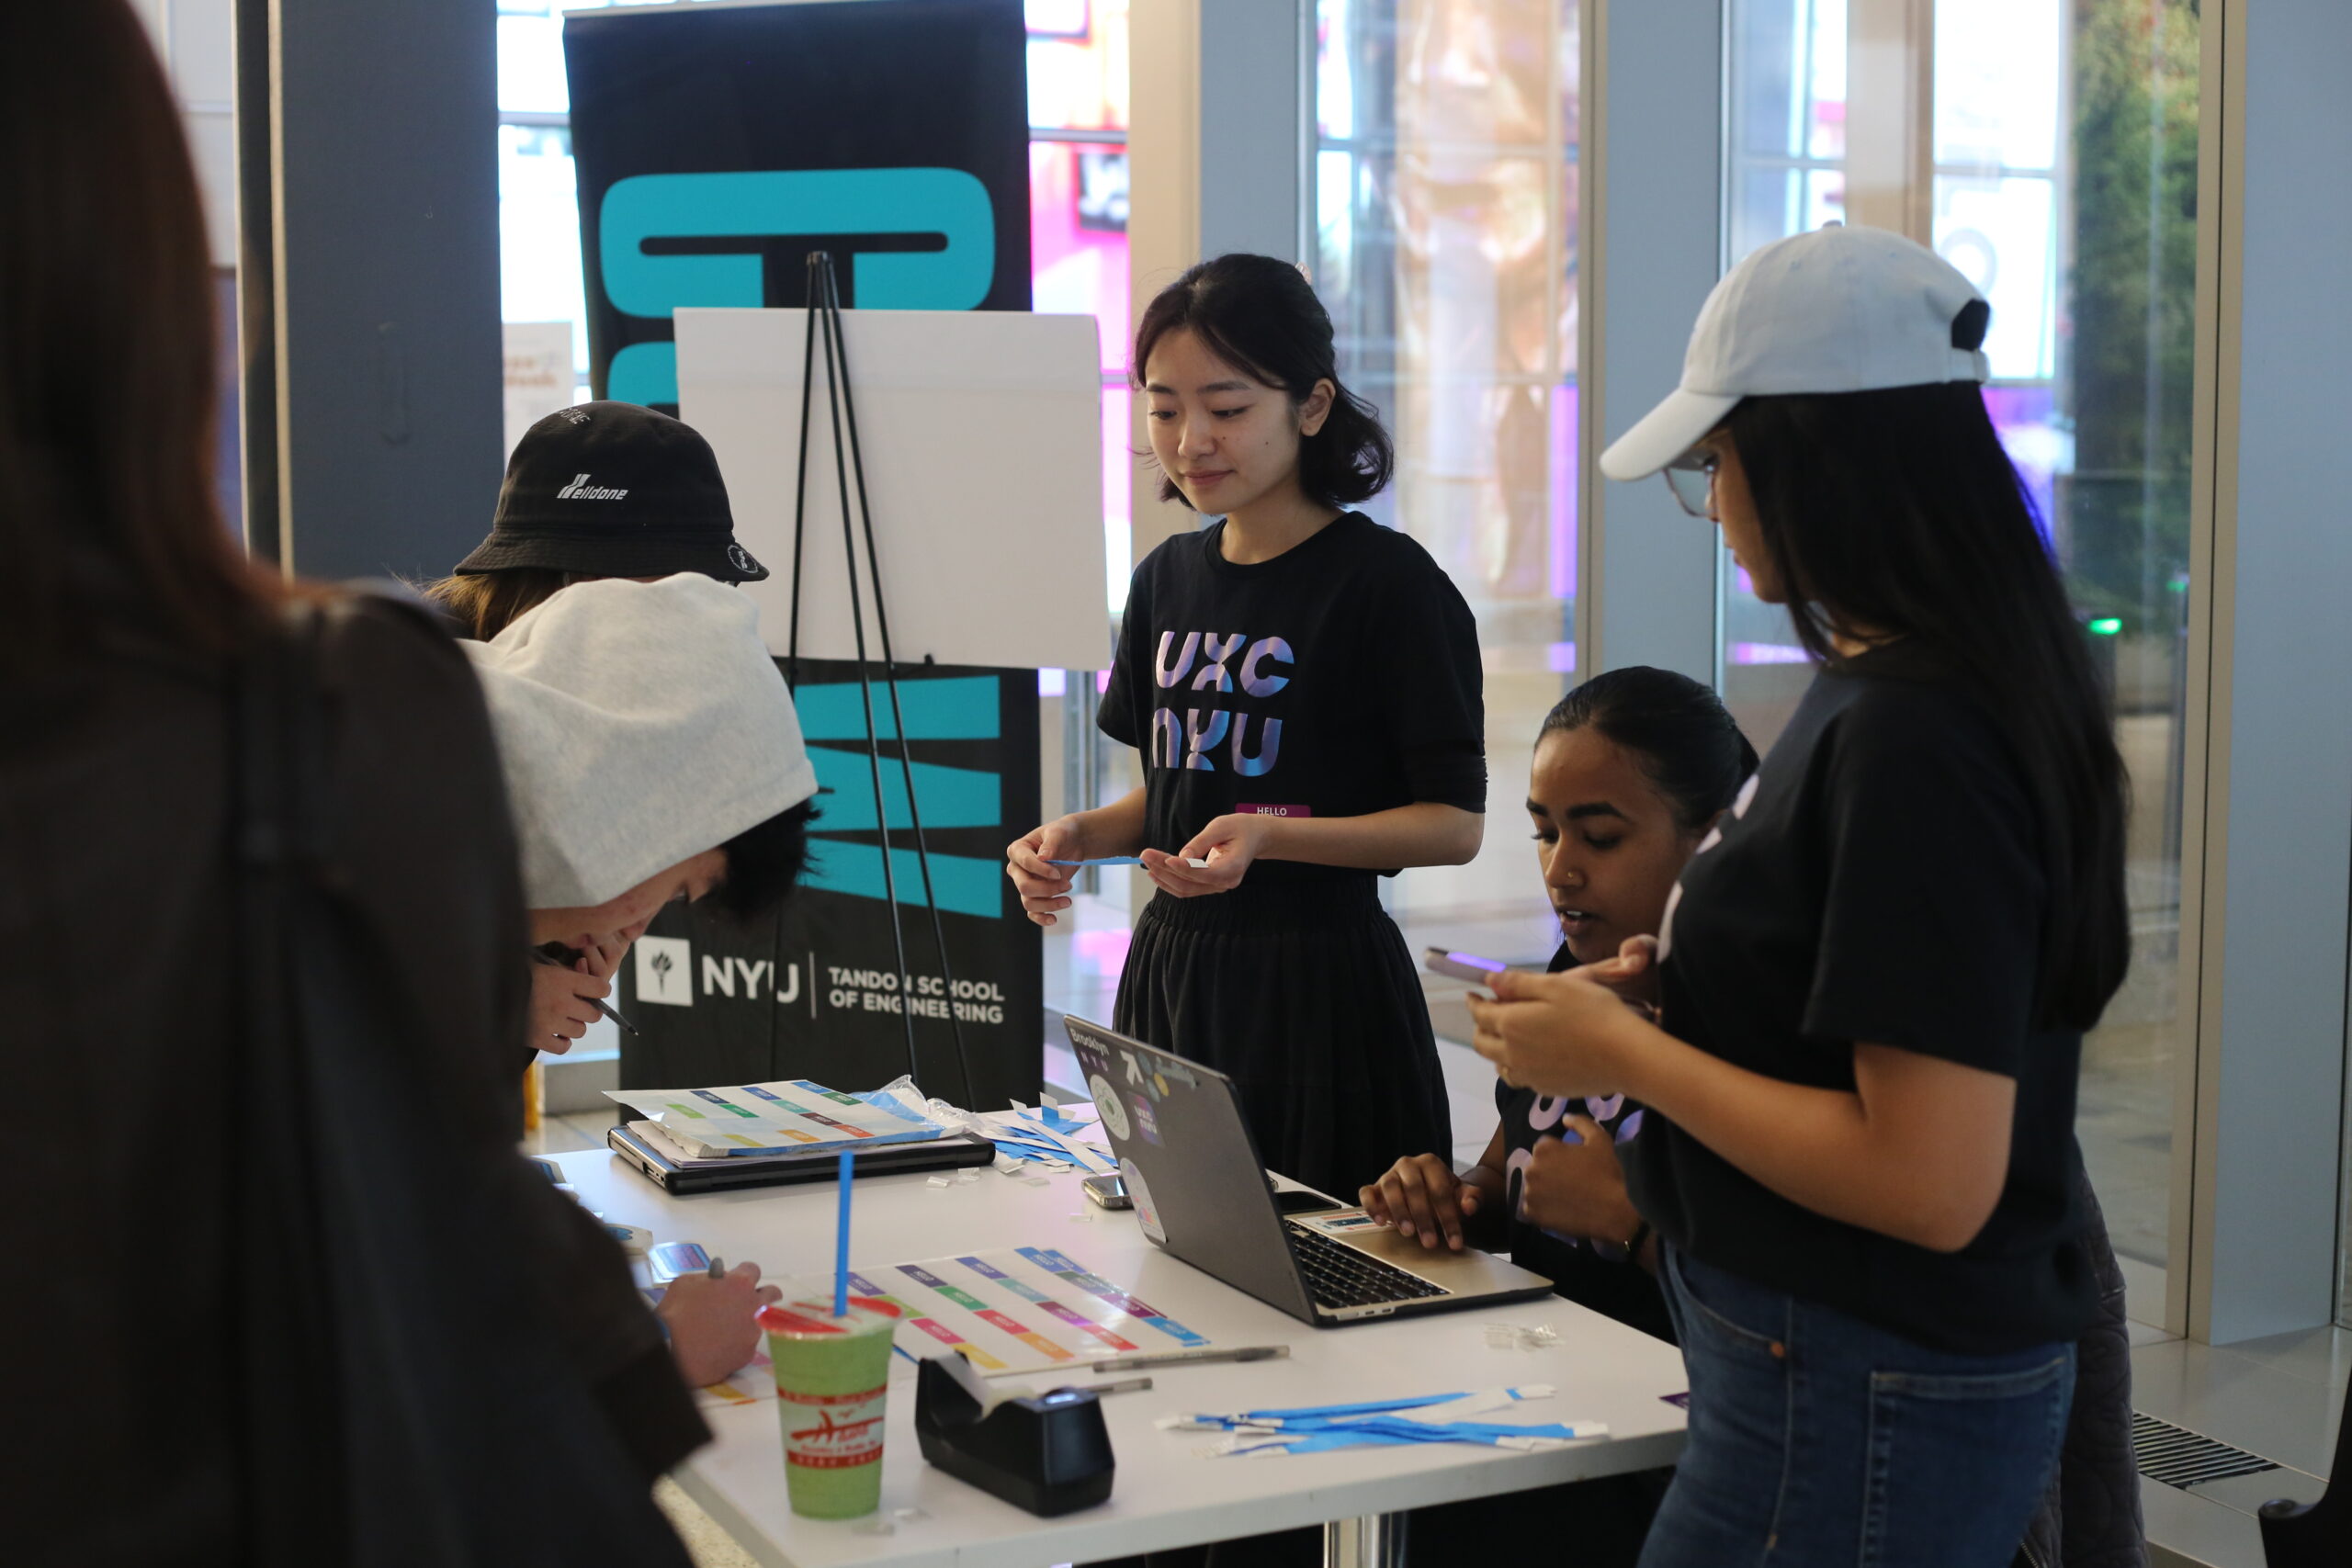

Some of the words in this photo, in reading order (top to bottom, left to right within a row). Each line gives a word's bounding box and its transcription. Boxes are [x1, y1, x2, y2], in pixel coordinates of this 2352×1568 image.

[1156, 630, 1295, 698] UXC
[1257, 807, 1287, 817] HELLO
[702, 953, 799, 1004] NYU
[830, 989, 858, 1009] OF
